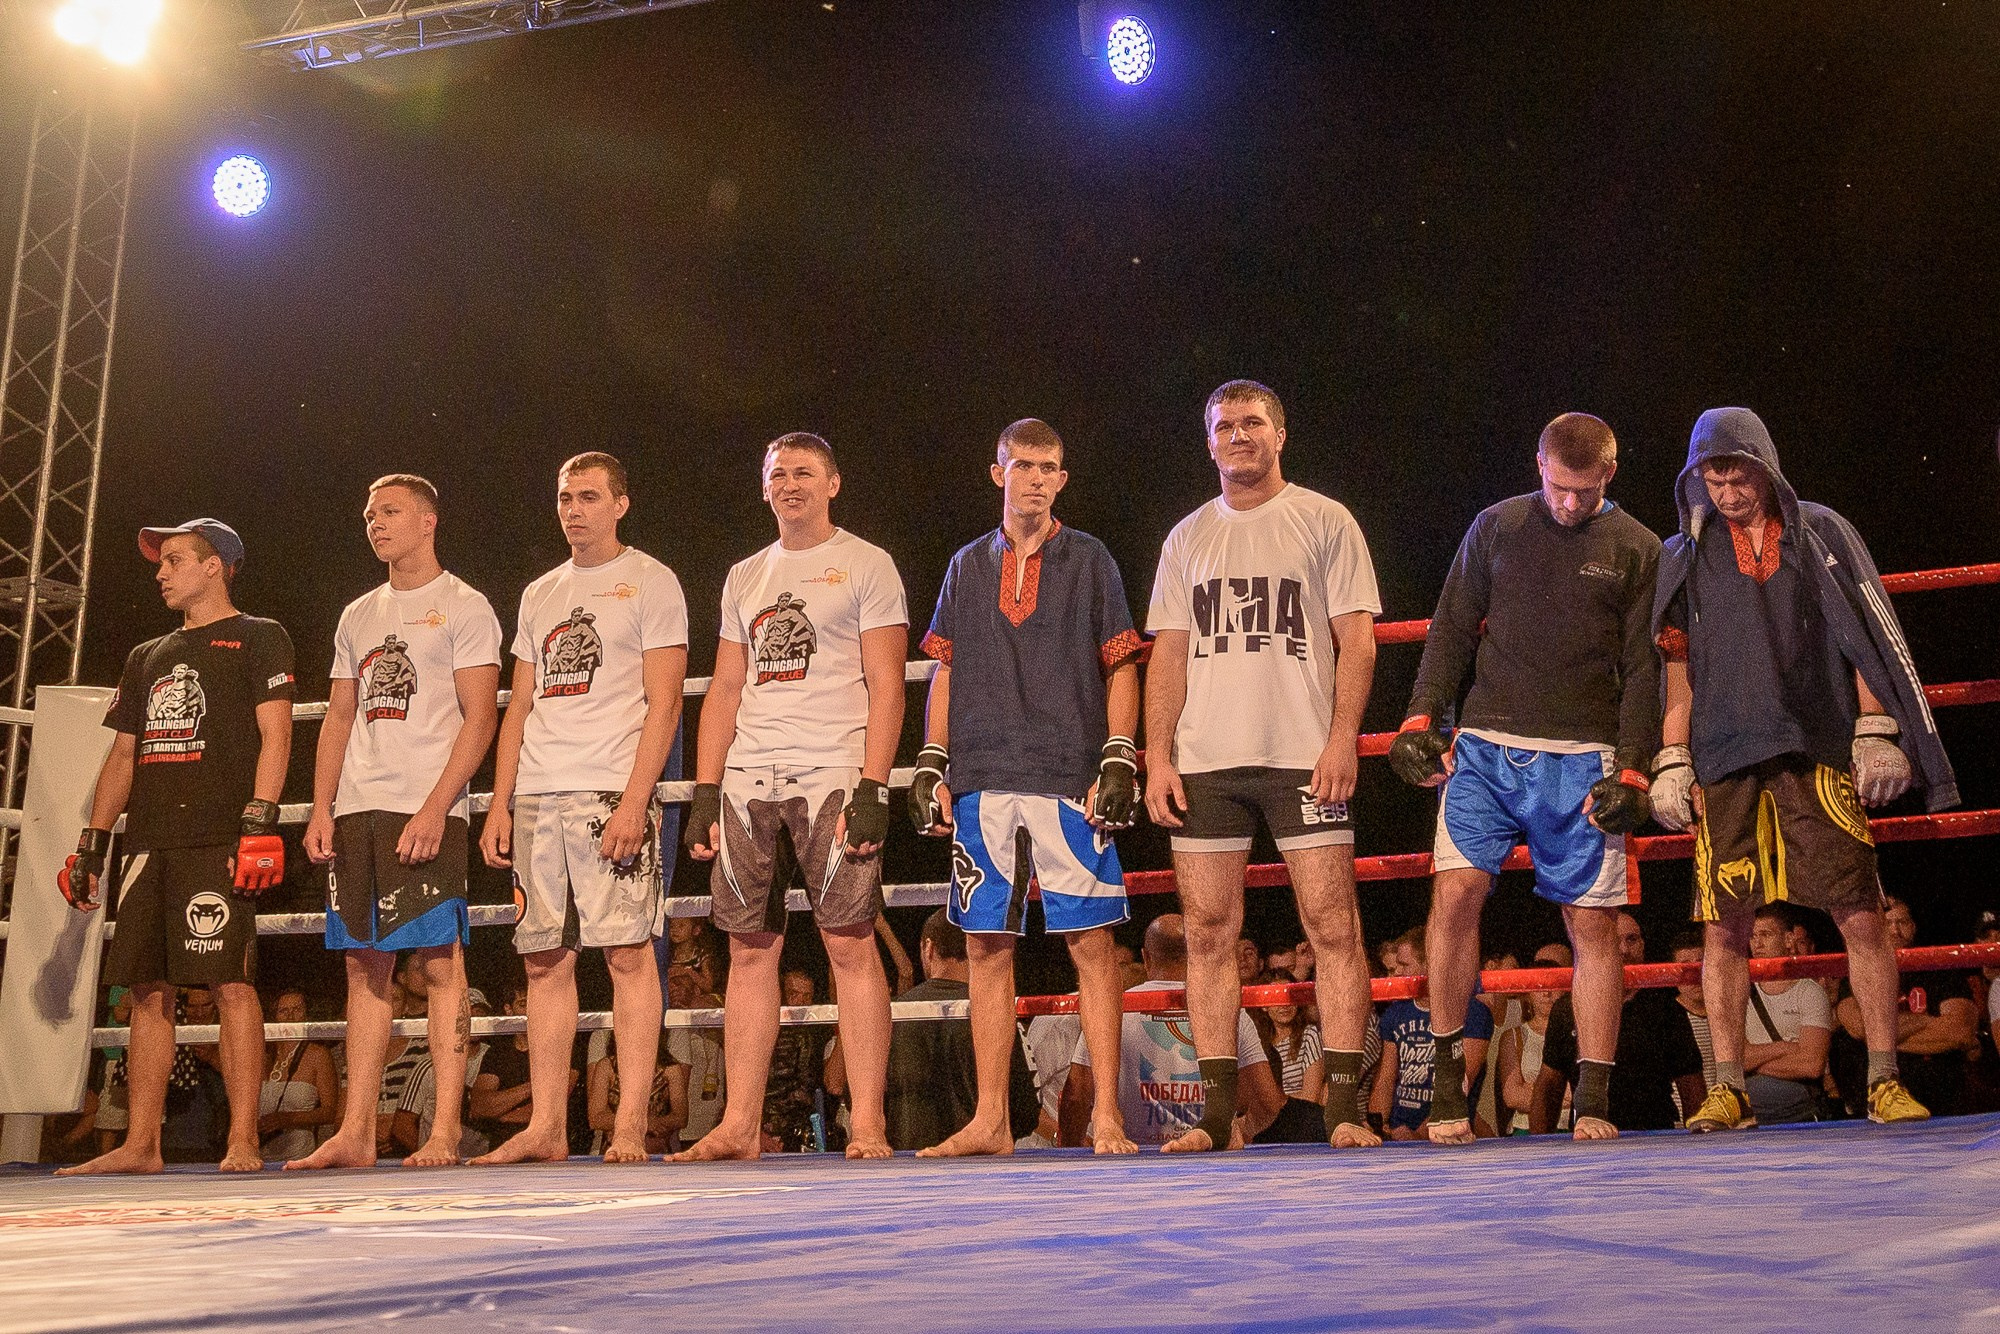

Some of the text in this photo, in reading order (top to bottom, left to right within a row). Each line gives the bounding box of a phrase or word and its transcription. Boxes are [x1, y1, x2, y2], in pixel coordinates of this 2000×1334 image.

[1192, 576, 1306, 638] MMA
[1193, 634, 1307, 661] LIFE
[545, 670, 590, 688] STALINGRAD
[564, 682, 588, 695] CLUB
[377, 708, 405, 719] CLUB
[146, 718, 195, 731] STALINGRAD
[153, 742, 187, 752] MARTIAL
[1303, 811, 1348, 825] BOY
[185, 939, 224, 954] VENUM
